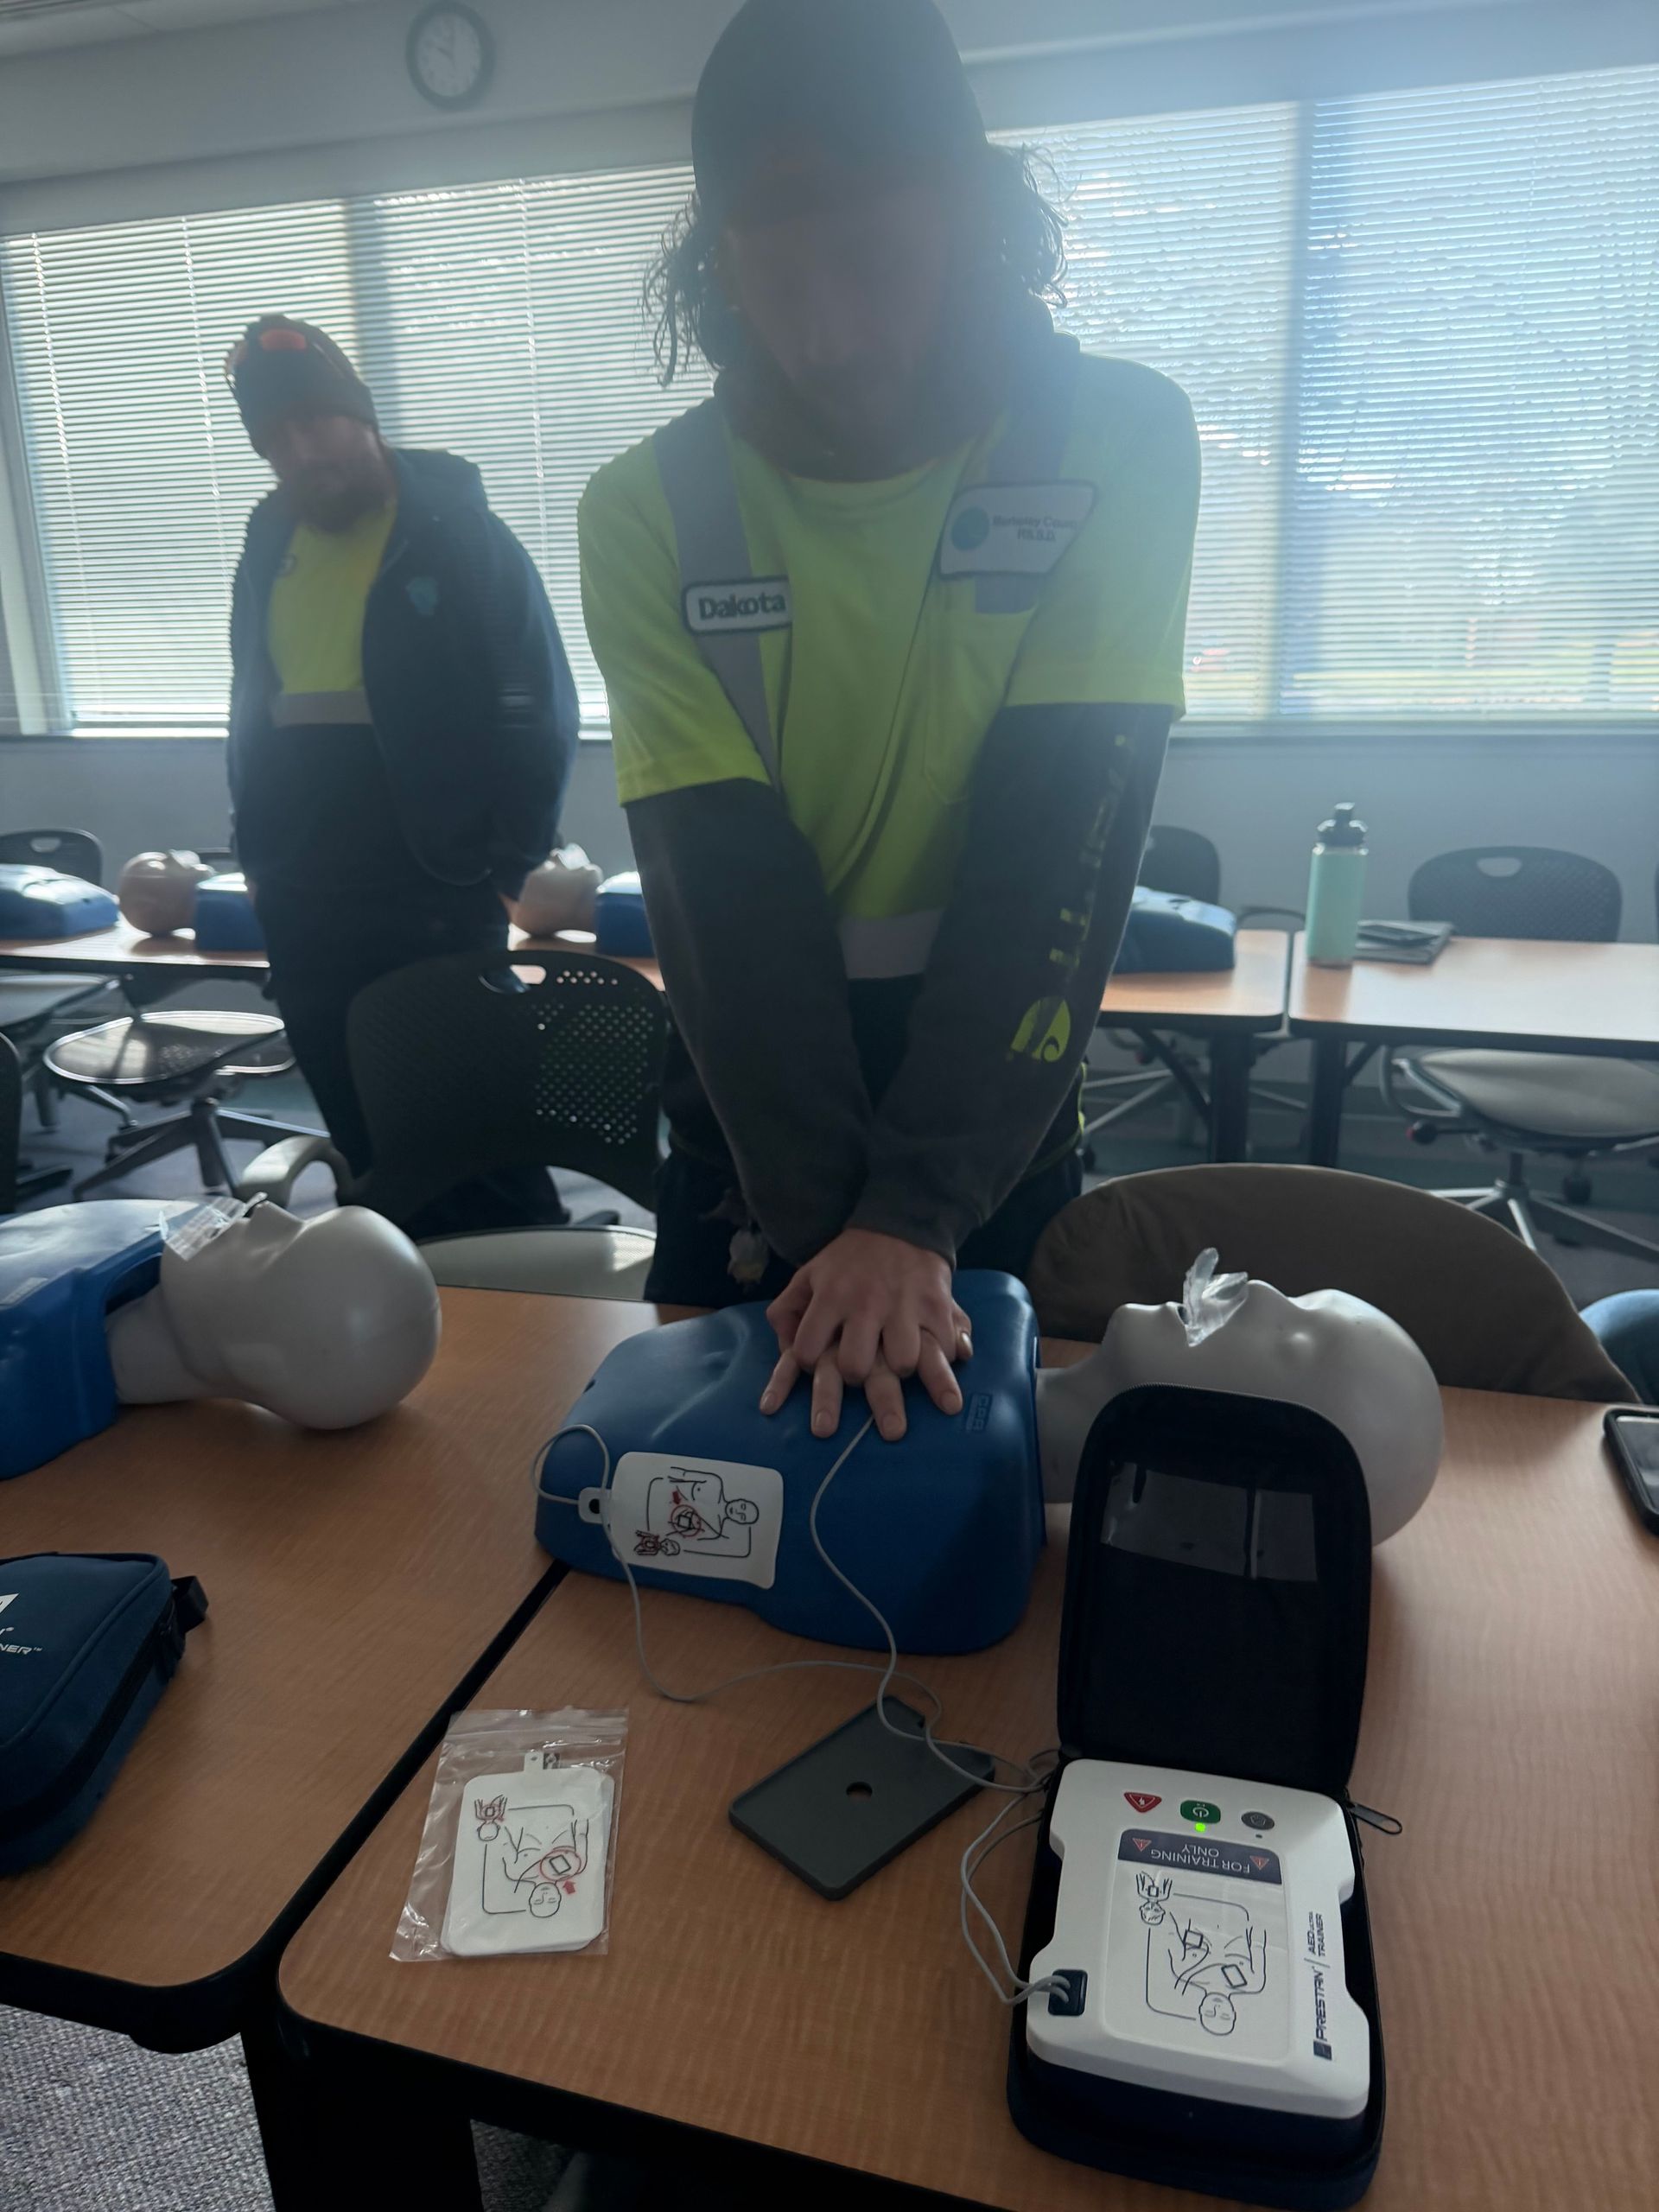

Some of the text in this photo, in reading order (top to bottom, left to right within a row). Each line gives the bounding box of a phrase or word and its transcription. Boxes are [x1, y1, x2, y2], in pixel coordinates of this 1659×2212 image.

[698, 591, 787, 621] Dakota
[1150, 1848, 1251, 1874] FOR TRAINING
[1180, 1843, 1220, 1858] ONLY
[1316, 1913, 1325, 1957] TRAINER
[1313, 1970, 1327, 2042] PRESTAN
